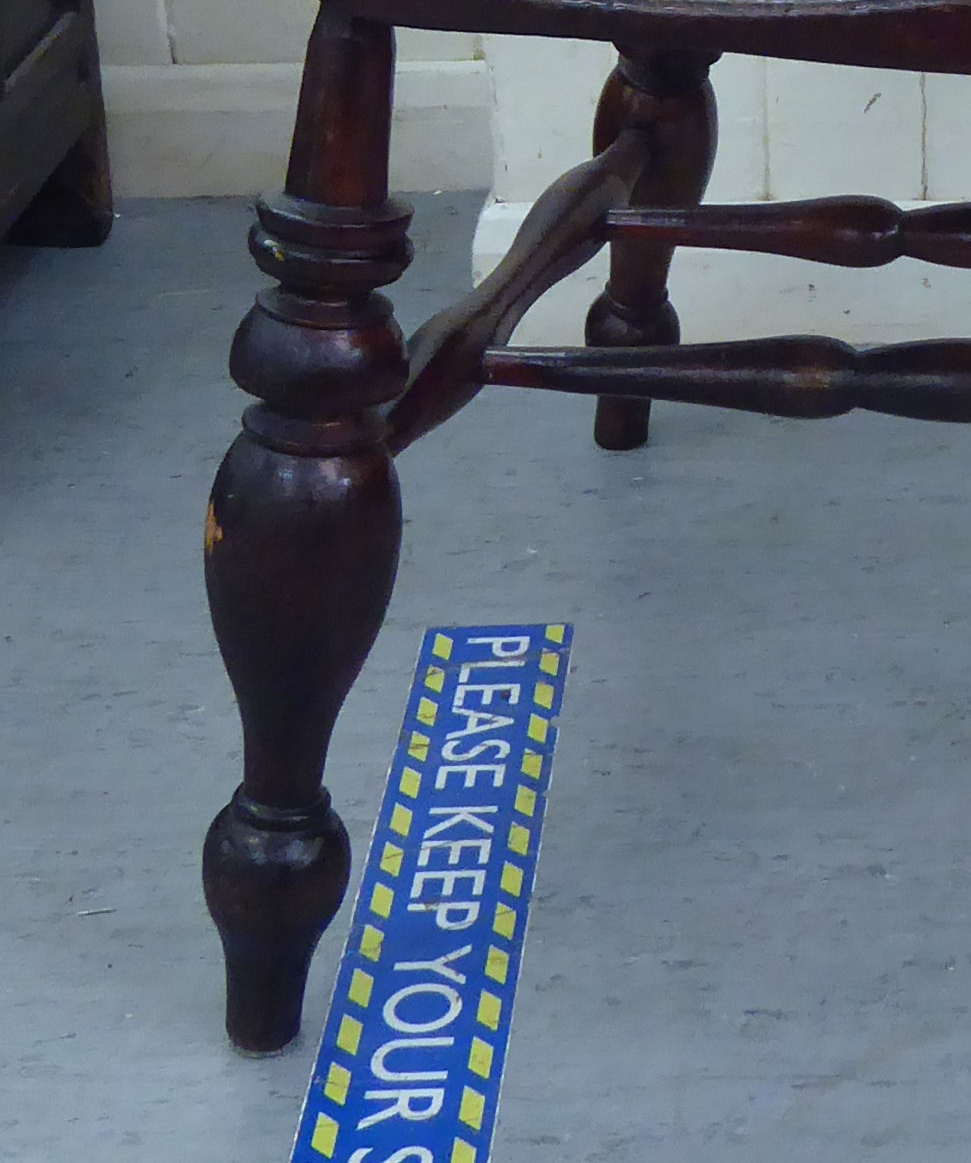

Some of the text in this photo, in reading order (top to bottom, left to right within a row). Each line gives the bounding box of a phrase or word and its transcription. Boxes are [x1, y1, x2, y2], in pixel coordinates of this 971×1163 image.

[434, 635, 530, 789] PLEASE
[406, 804, 499, 931] KEEP
[355, 943, 473, 1131] YOUR
